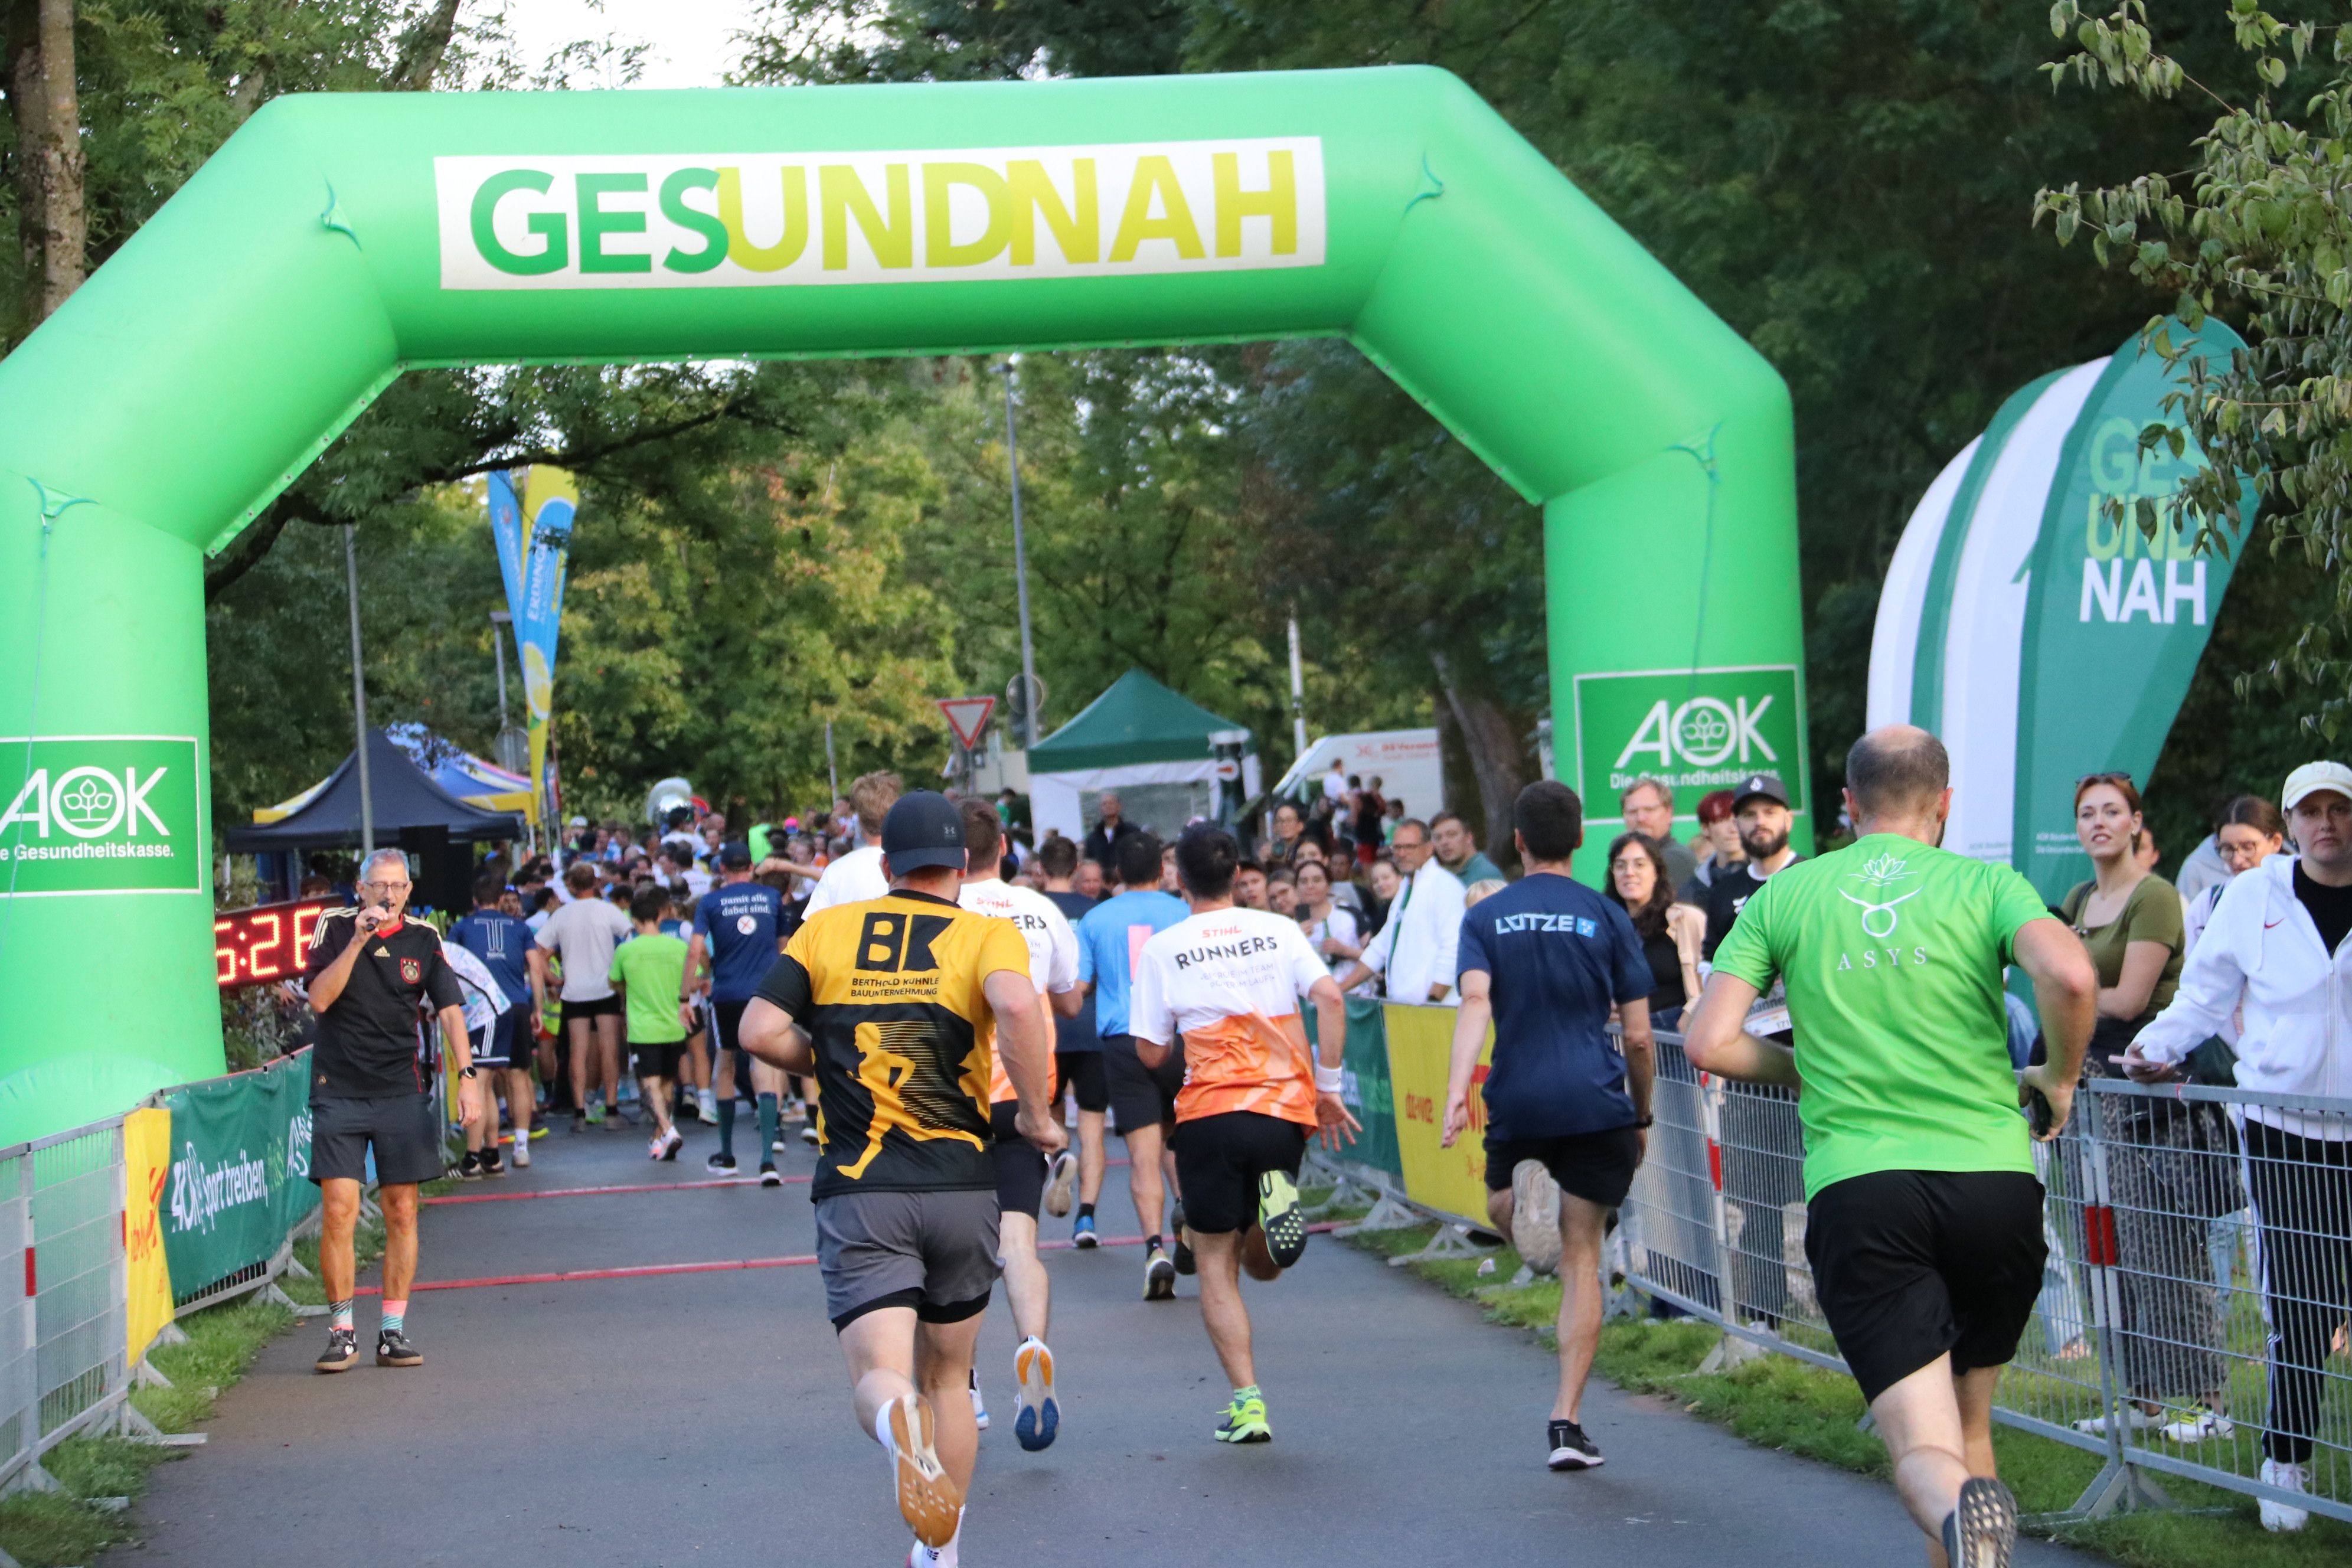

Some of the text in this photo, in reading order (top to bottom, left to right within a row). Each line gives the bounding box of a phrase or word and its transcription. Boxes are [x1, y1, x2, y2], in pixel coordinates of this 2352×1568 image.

[2079, 557, 2207, 625] NAH
[1613, 694, 1778, 769] AOK
[1609, 773, 1634, 789] Die
[0, 766, 171, 838] AOK
[14, 841, 175, 860] Gesundheitskasse.
[720, 893, 767, 906] Damit alle
[976, 897, 1014, 909] STIHL
[722, 904, 747, 917] dabei
[1202, 925, 1243, 938] STIHL
[855, 912, 955, 974] BK
[1174, 936, 1278, 970] RUNNERS
[1837, 946, 1927, 971] ASYS
[852, 977, 900, 987] BERTHOLD
[851, 987, 937, 998] BAUUNTERNEHMUNG
[224, 1147, 269, 1208] treiben,
